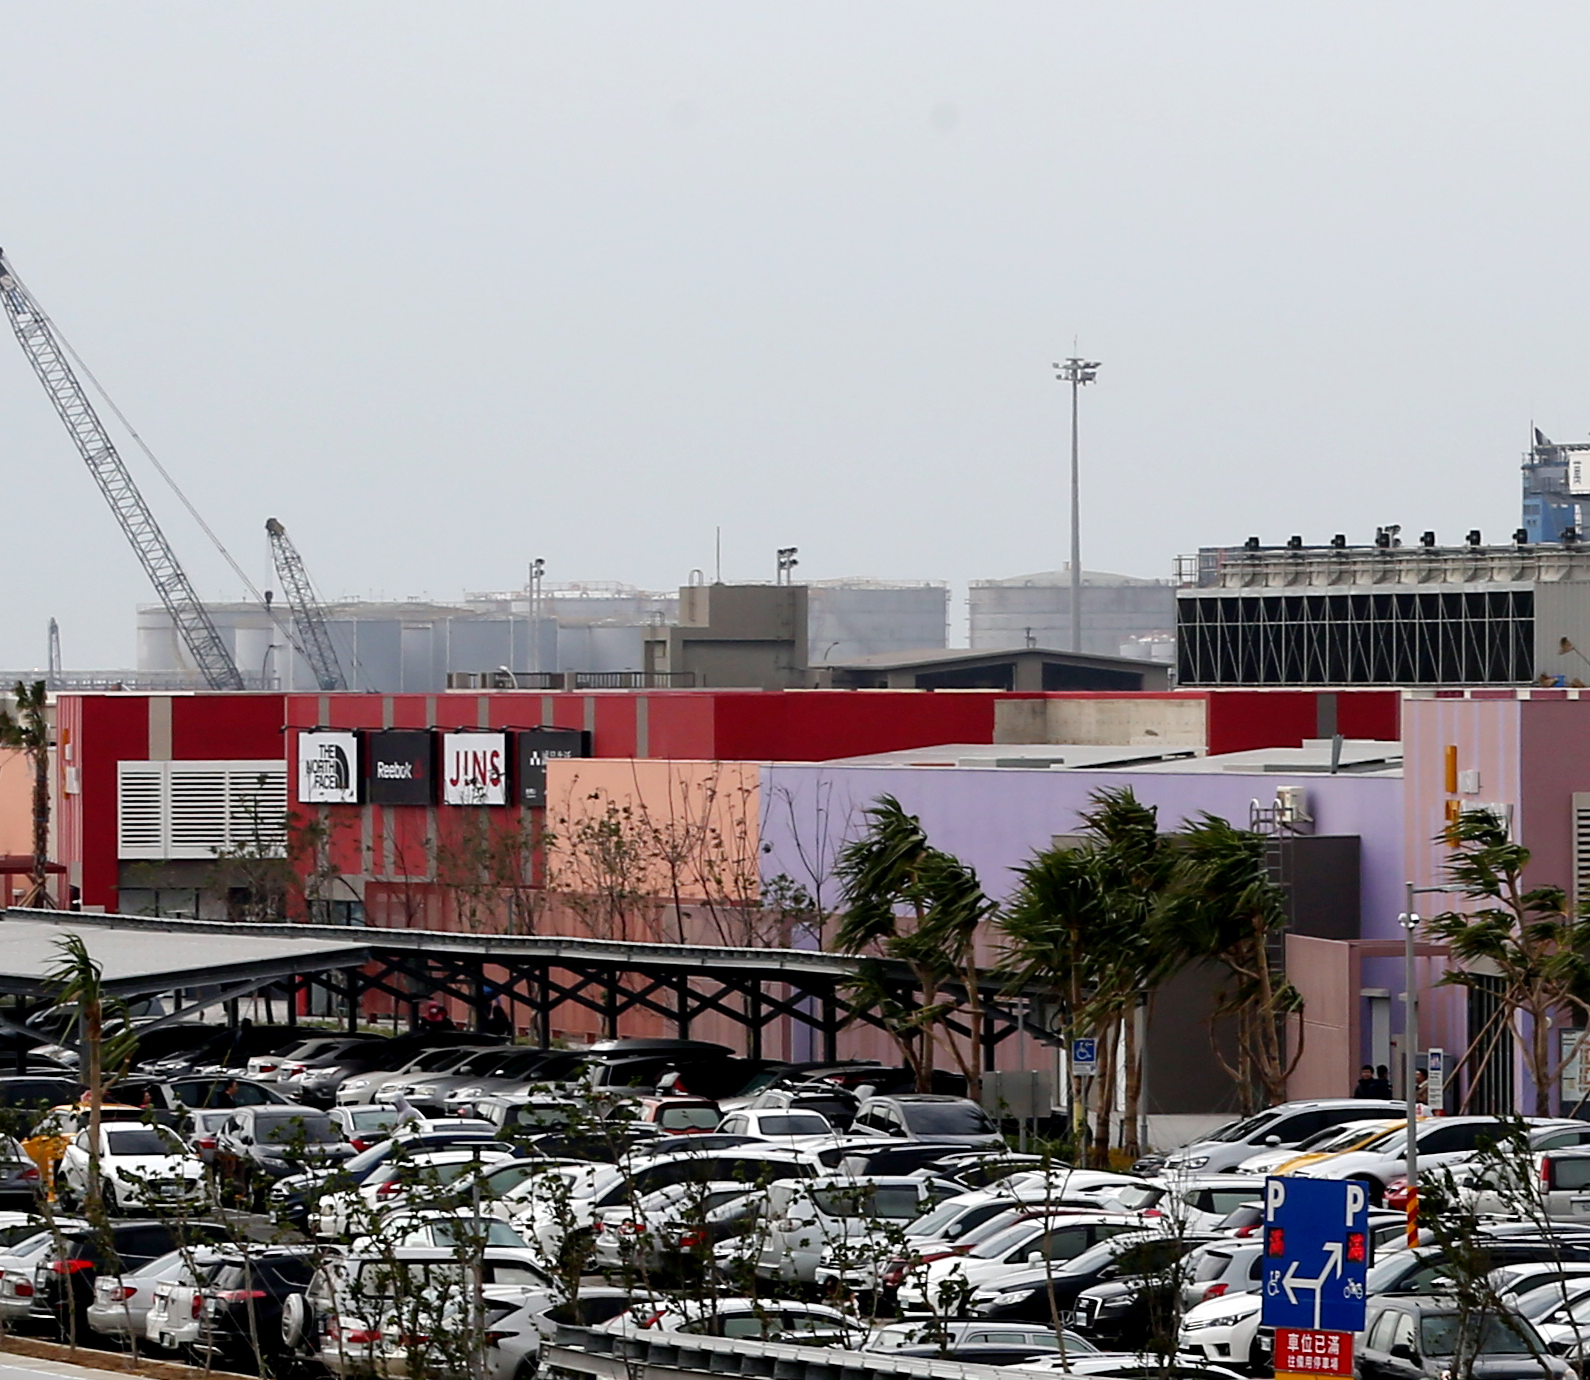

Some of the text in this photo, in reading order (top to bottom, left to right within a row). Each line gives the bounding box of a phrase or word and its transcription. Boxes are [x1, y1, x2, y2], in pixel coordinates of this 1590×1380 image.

[319, 744, 335, 758] THE
[307, 760, 335, 773] NORTH
[377, 761, 412, 779] Reebok
[450, 750, 500, 787] JINS
[315, 774, 335, 788] FACE
[1267, 1180, 1286, 1222] P
[1346, 1184, 1365, 1227] P
[1287, 1333, 1340, 1355] 車位已滿
